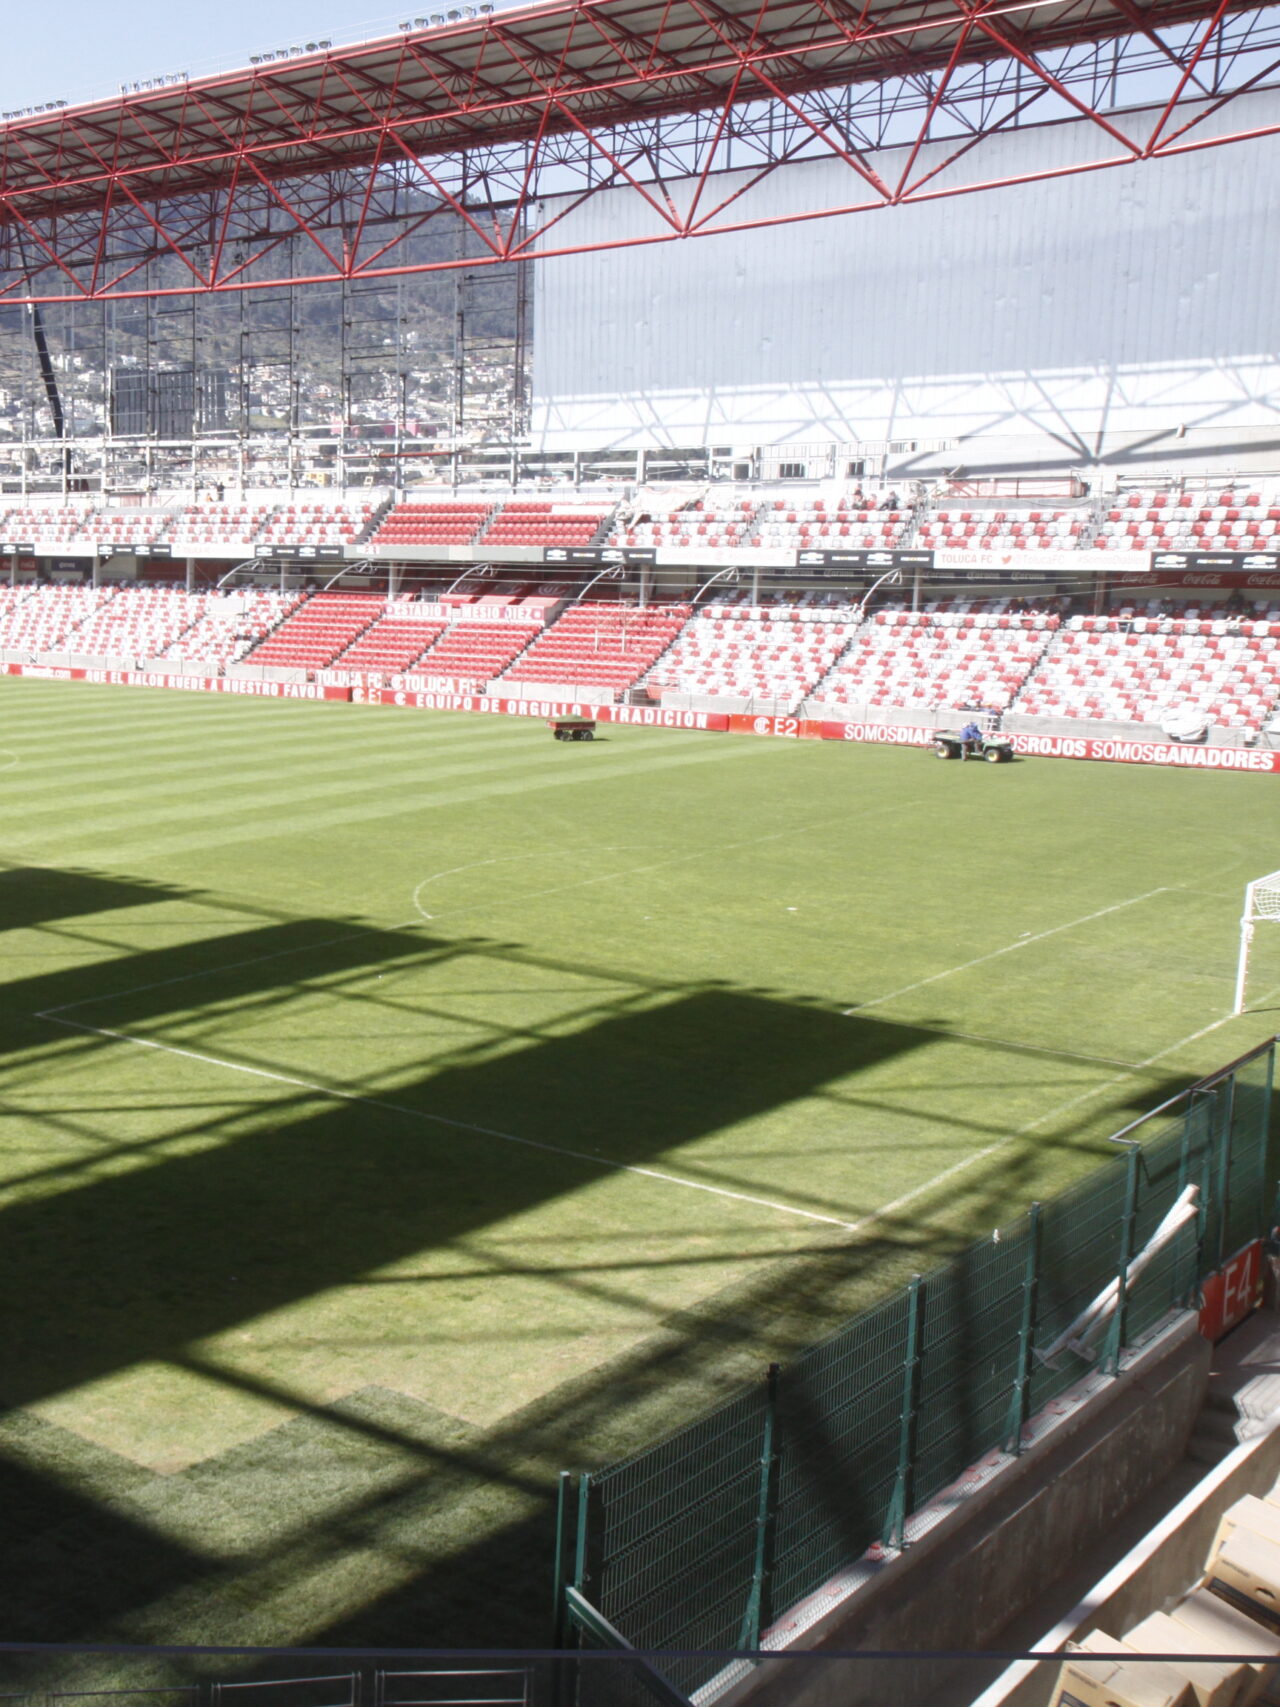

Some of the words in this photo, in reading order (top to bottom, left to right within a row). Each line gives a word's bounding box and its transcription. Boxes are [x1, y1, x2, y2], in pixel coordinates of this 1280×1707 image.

[941, 554, 977, 564] TOLUCA
[981, 554, 993, 564] FC
[394, 603, 442, 617] ESTADIO
[505, 606, 532, 620] DIEZ
[86, 669, 107, 684] QUE
[110, 671, 124, 685] EL
[168, 674, 206, 690] RUEDE
[210, 678, 218, 691] A
[222, 679, 279, 696] NUESTRO
[283, 682, 325, 699] FAVOR
[367, 672, 382, 689] FC
[404, 673, 455, 693] TOLUCA
[416, 692, 473, 710] EQUIPO
[480, 696, 500, 713] DE
[590, 705, 601, 720] Y
[774, 717, 798, 737] E2
[1091, 740, 1275, 771] SOMOSGANADORES
[1221, 1251, 1252, 1326] E4
